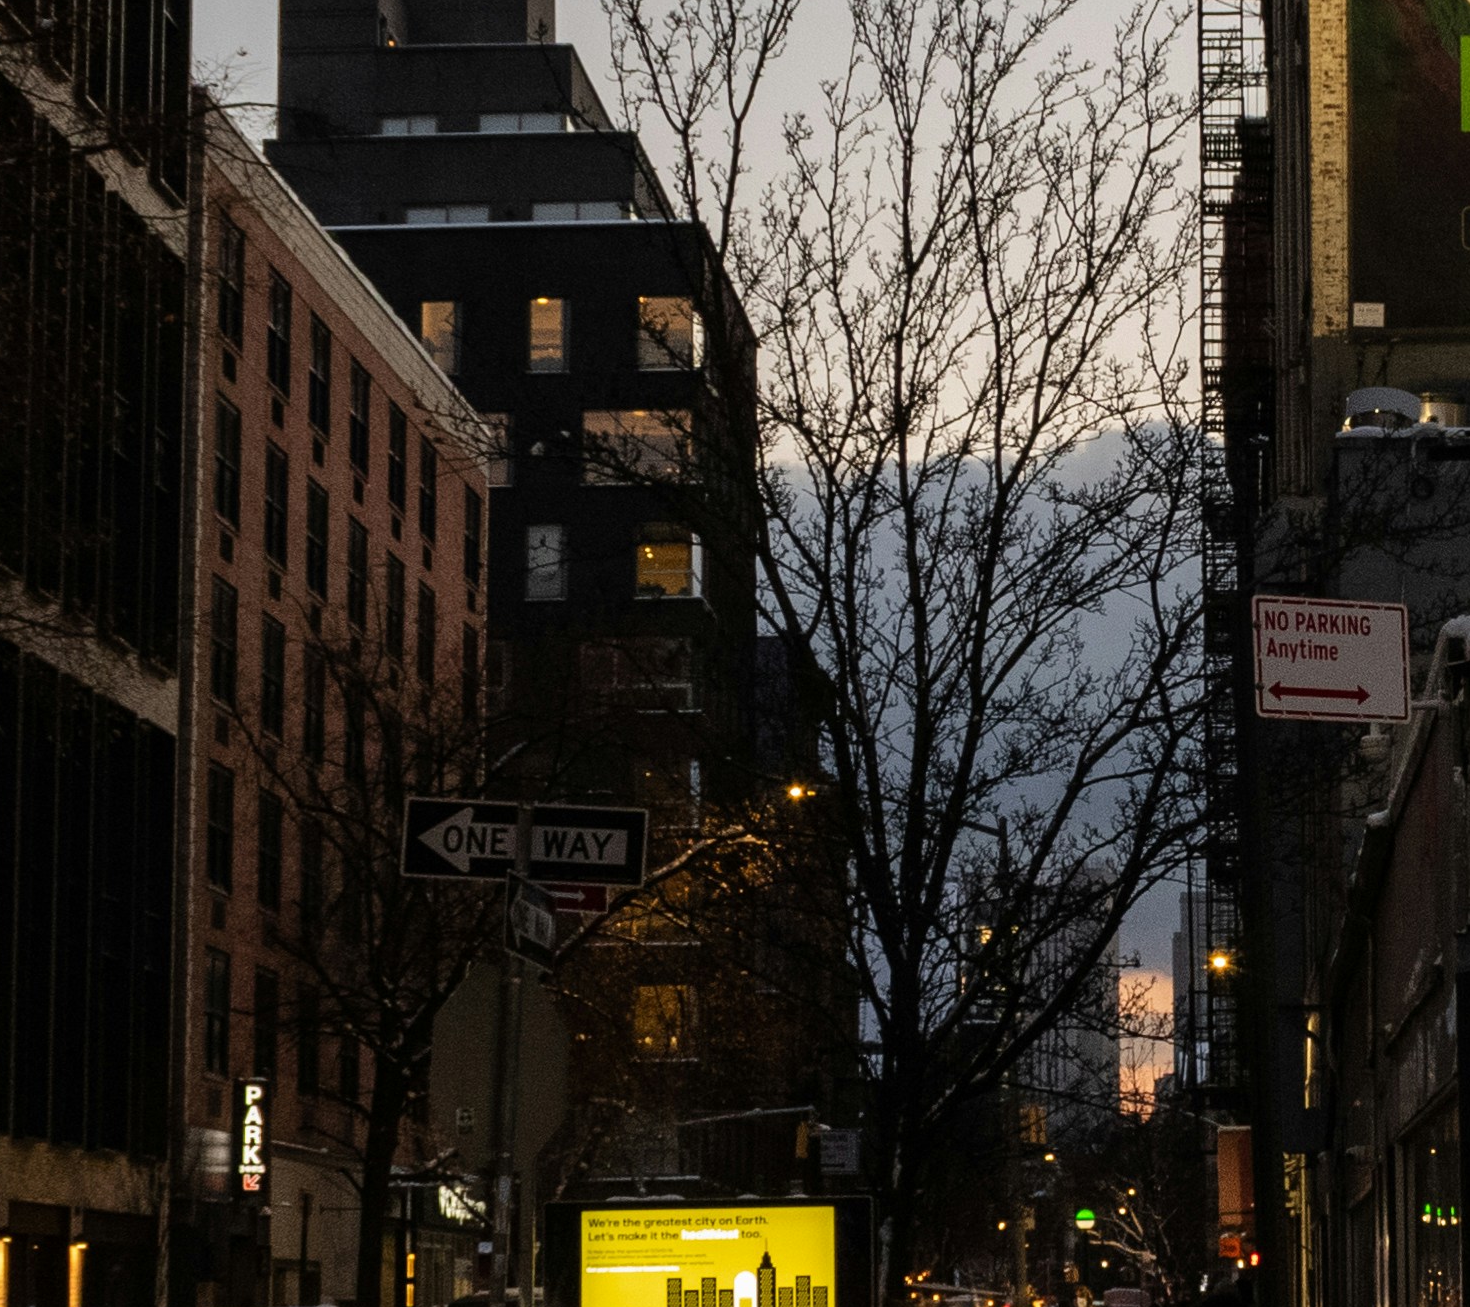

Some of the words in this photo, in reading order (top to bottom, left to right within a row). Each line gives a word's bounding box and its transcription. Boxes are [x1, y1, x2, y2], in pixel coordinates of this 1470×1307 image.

[1263, 610, 1289, 632] NO
[1294, 612, 1372, 637] PARKING
[1265, 637, 1339, 664] Anytime
[442, 824, 509, 856] ONE
[542, 829, 614, 862] WAY
[241, 1084, 264, 1166] PARK
[588, 1218, 620, 1229] We're
[623, 1218, 643, 1228] the
[644, 1218, 692, 1230] greatest
[694, 1217, 716, 1228] city
[719, 1218, 733, 1226] on
[588, 1232, 615, 1242] Let's
[618, 1231, 648, 1241] make
[651, 1231, 658, 1241] it
[661, 1231, 679, 1241] the
